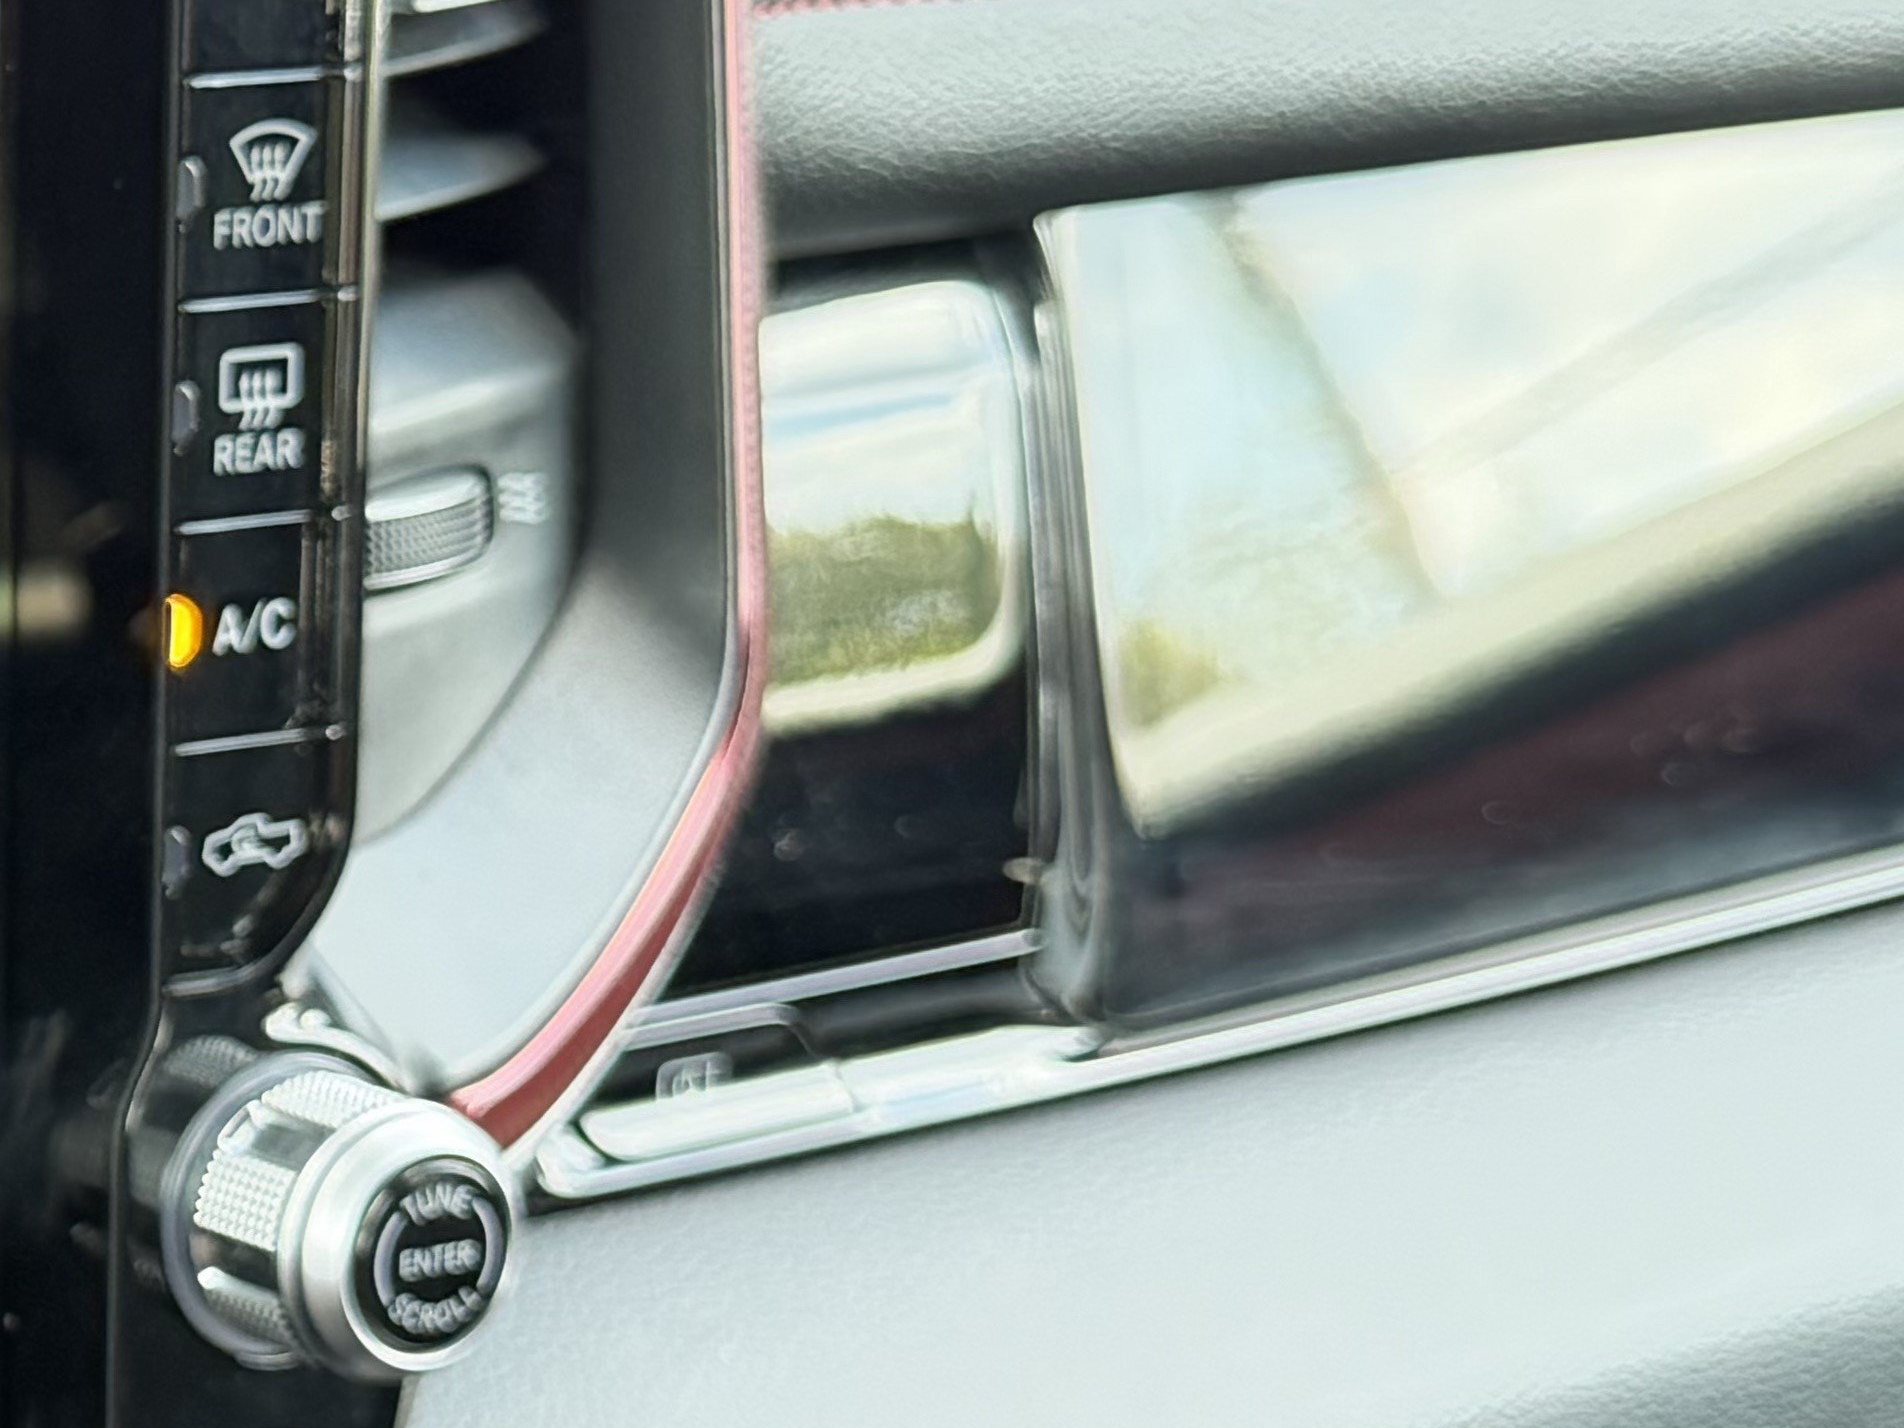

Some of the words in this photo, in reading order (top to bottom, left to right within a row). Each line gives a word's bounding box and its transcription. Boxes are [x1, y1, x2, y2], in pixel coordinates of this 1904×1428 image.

[213, 199, 328, 249] FRONT
[212, 428, 305, 477] REAR
[212, 595, 297, 657] A/C
[403, 1181, 477, 1225] TUNE
[398, 1239, 482, 1282] ENTER
[387, 1285, 482, 1335] SCROLL
